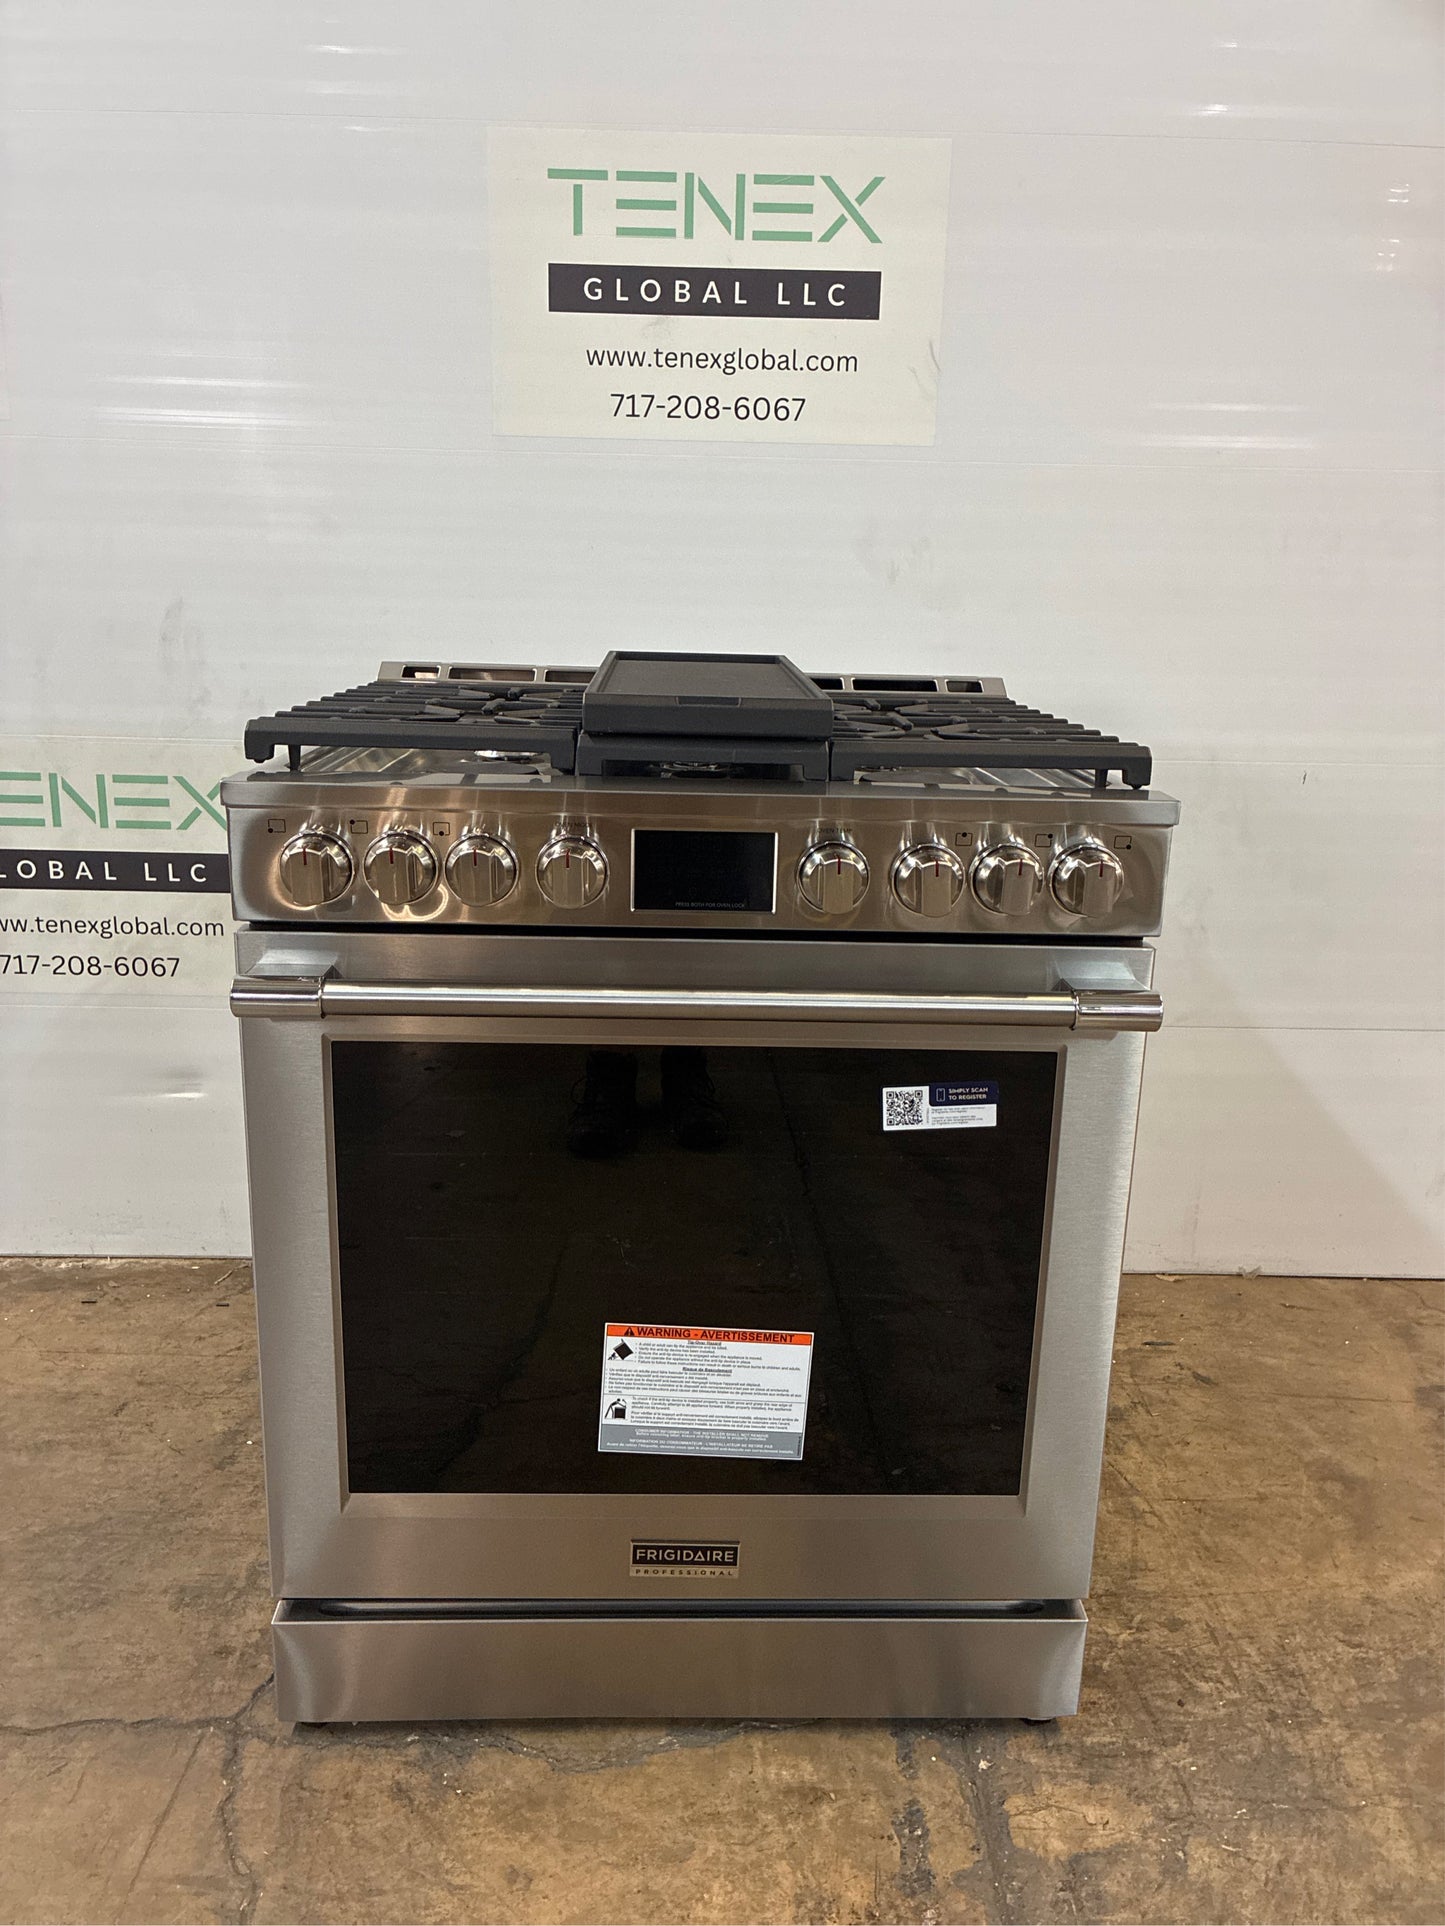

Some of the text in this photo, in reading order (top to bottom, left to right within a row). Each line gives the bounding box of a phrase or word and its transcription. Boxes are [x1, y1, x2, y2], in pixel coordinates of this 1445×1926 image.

[547, 168, 886, 244] TENEX
[583, 277, 846, 307] GLOBAL LLC
[586, 347, 858, 376] www.tenexglobal.com
[610, 393, 806, 421] 717-208-6067
[0, 859, 207, 883] OBAL LLC
[0, 955, 180, 977] 717-208-6067
[637, 1327, 691, 1338] WARNING
[701, 1330, 795, 1343] AVERTISSEMENT
[636, 1549, 734, 1562] FRIGIDAIRE
